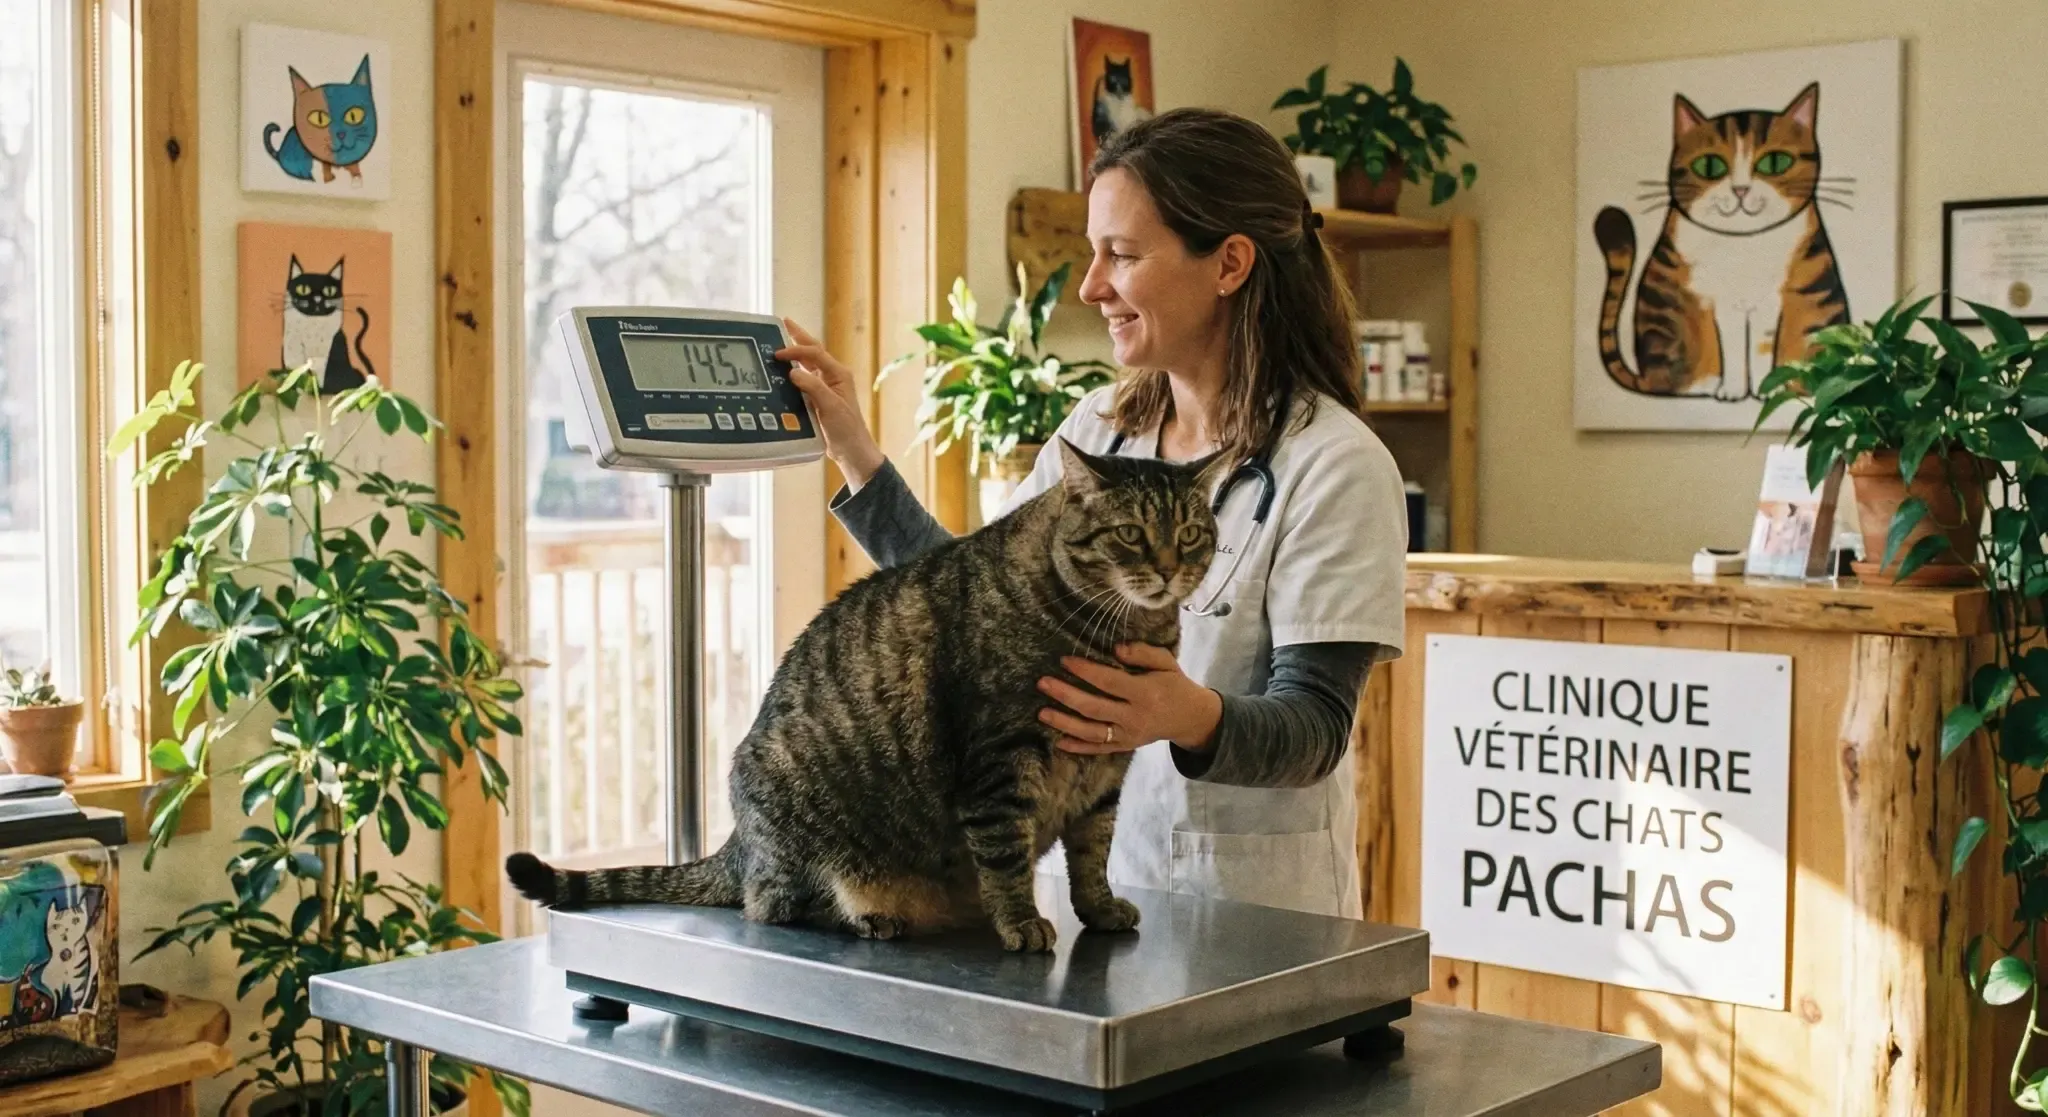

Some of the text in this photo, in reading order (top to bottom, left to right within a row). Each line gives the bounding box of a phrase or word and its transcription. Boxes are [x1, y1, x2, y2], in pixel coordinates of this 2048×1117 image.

[683, 343, 739, 386] 14.5
[1492, 670, 1710, 727] CLINIQUE
[1453, 721, 1752, 794] VÉTÉRINAIRE
[1476, 787, 1724, 854] DES CHATS
[1462, 849, 1737, 944] PACHAS
